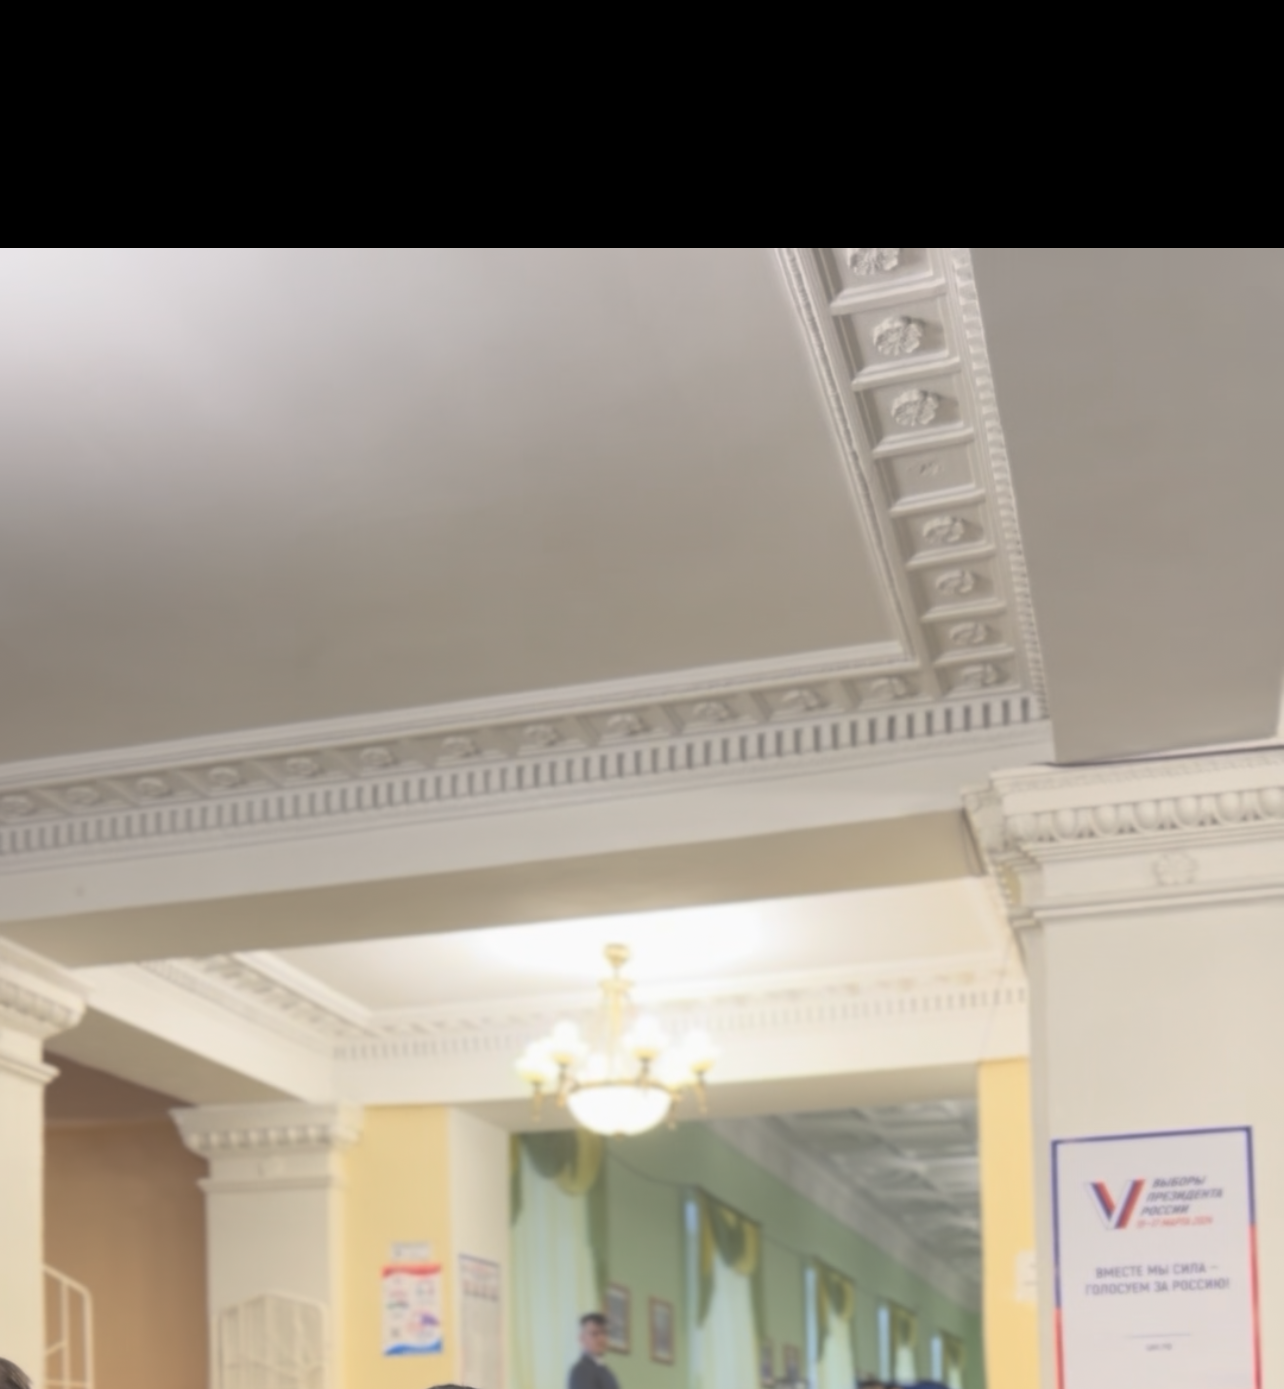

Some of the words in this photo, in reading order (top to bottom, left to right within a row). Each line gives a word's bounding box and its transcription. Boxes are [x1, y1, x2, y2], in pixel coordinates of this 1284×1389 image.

[1152, 1175, 1206, 1188] ВЫБОРЫ
[1146, 1188, 1224, 1203] ПРЕЗИДЕНТА
[1141, 1204, 1190, 1217] РОССИИ
[1095, 1265, 1143, 1279] ВМЕСТЕ
[1147, 1264, 1169, 1276] МЫ
[1173, 1262, 1207, 1275] СИЛА
[1085, 1282, 1150, 1296] ГОЛОСУЕМ
[1154, 1281, 1169, 1293] ЗА
[1172, 1277, 1230, 1292] РОССИЮ!
